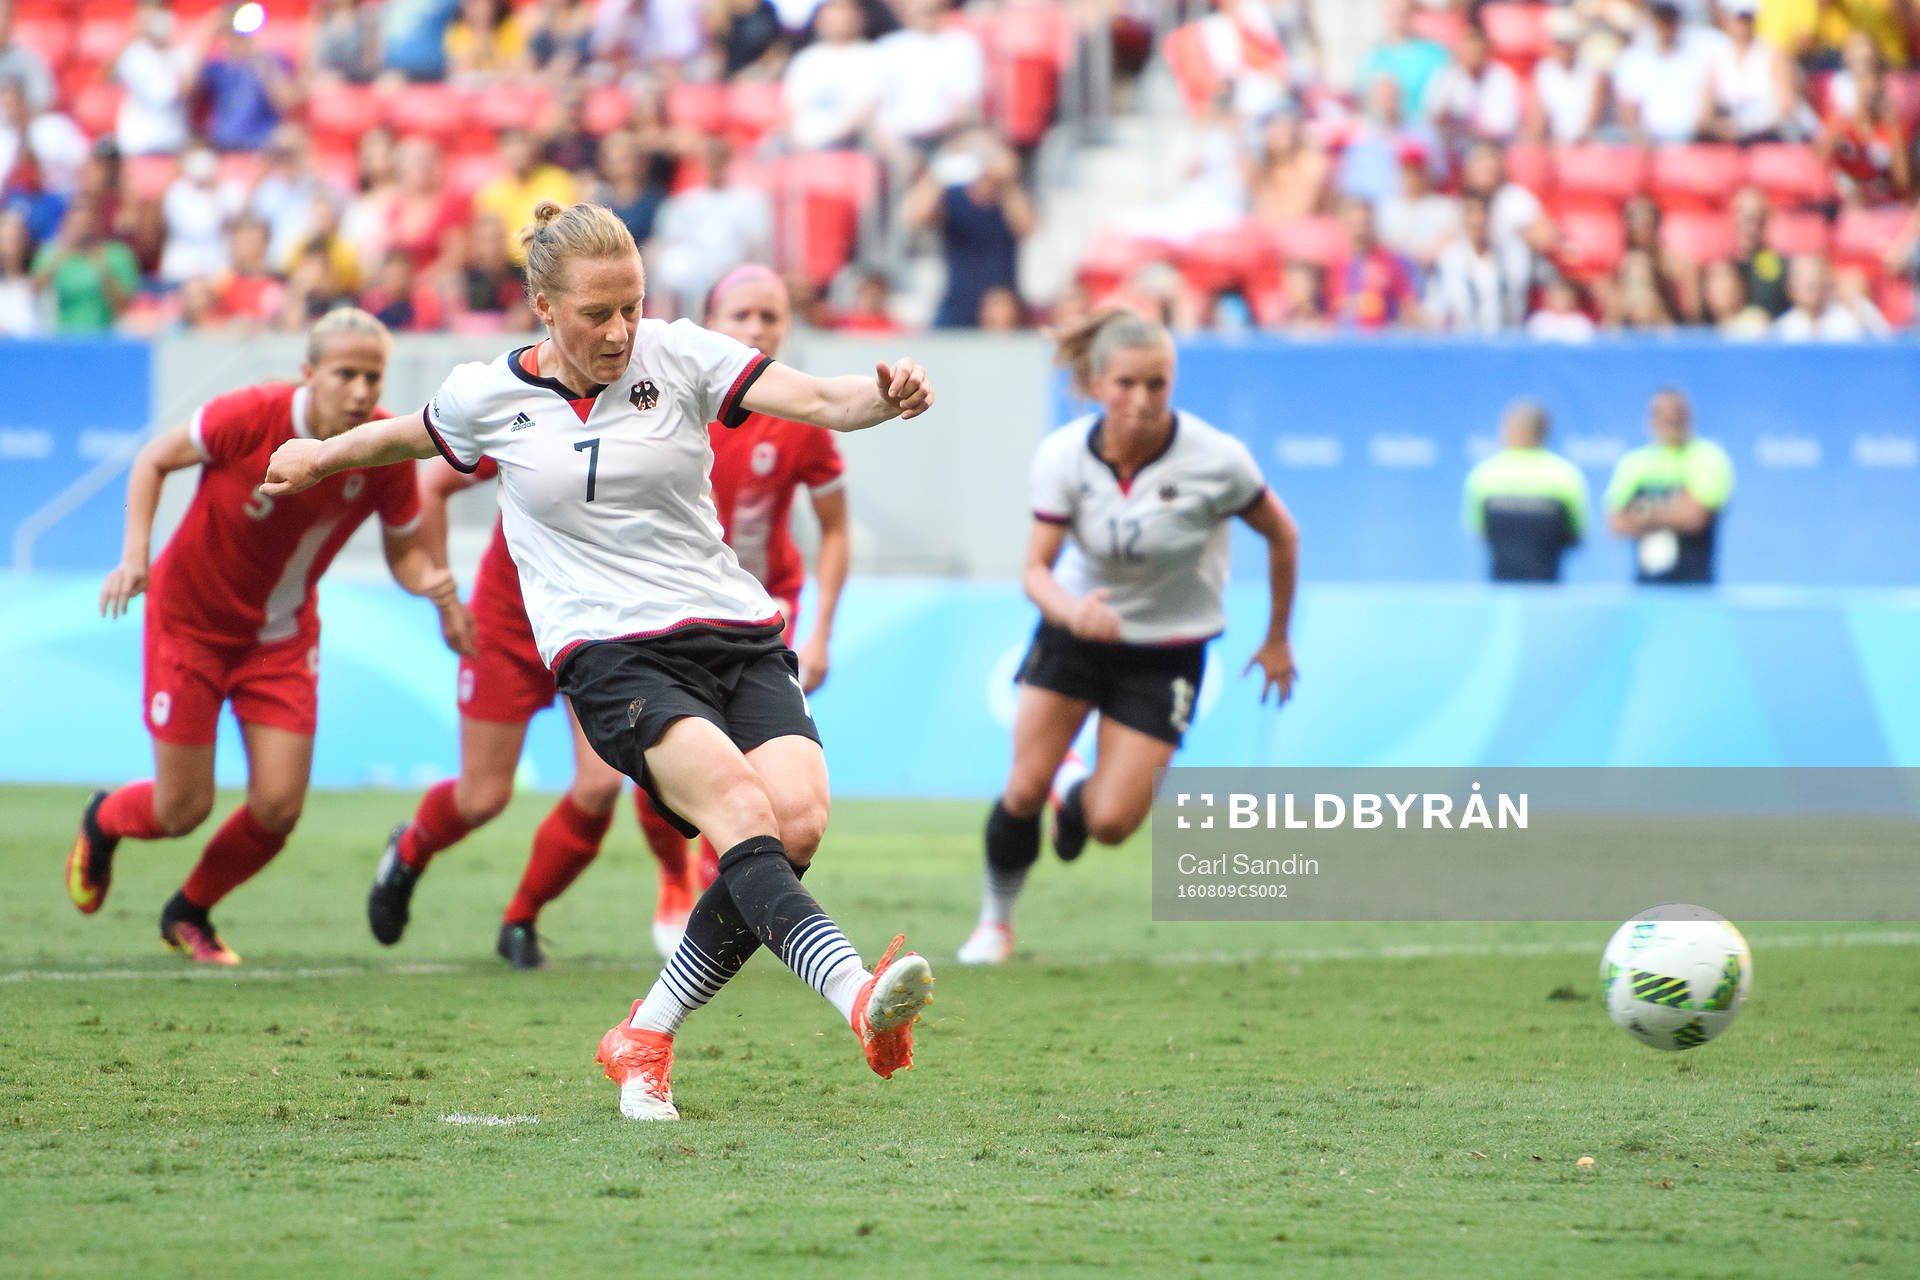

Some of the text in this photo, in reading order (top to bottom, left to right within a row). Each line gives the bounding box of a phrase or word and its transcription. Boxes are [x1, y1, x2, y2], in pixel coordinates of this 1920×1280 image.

[511, 421, 536, 432] adidas
[573, 437, 600, 503] 7
[1107, 517, 1145, 561] 12
